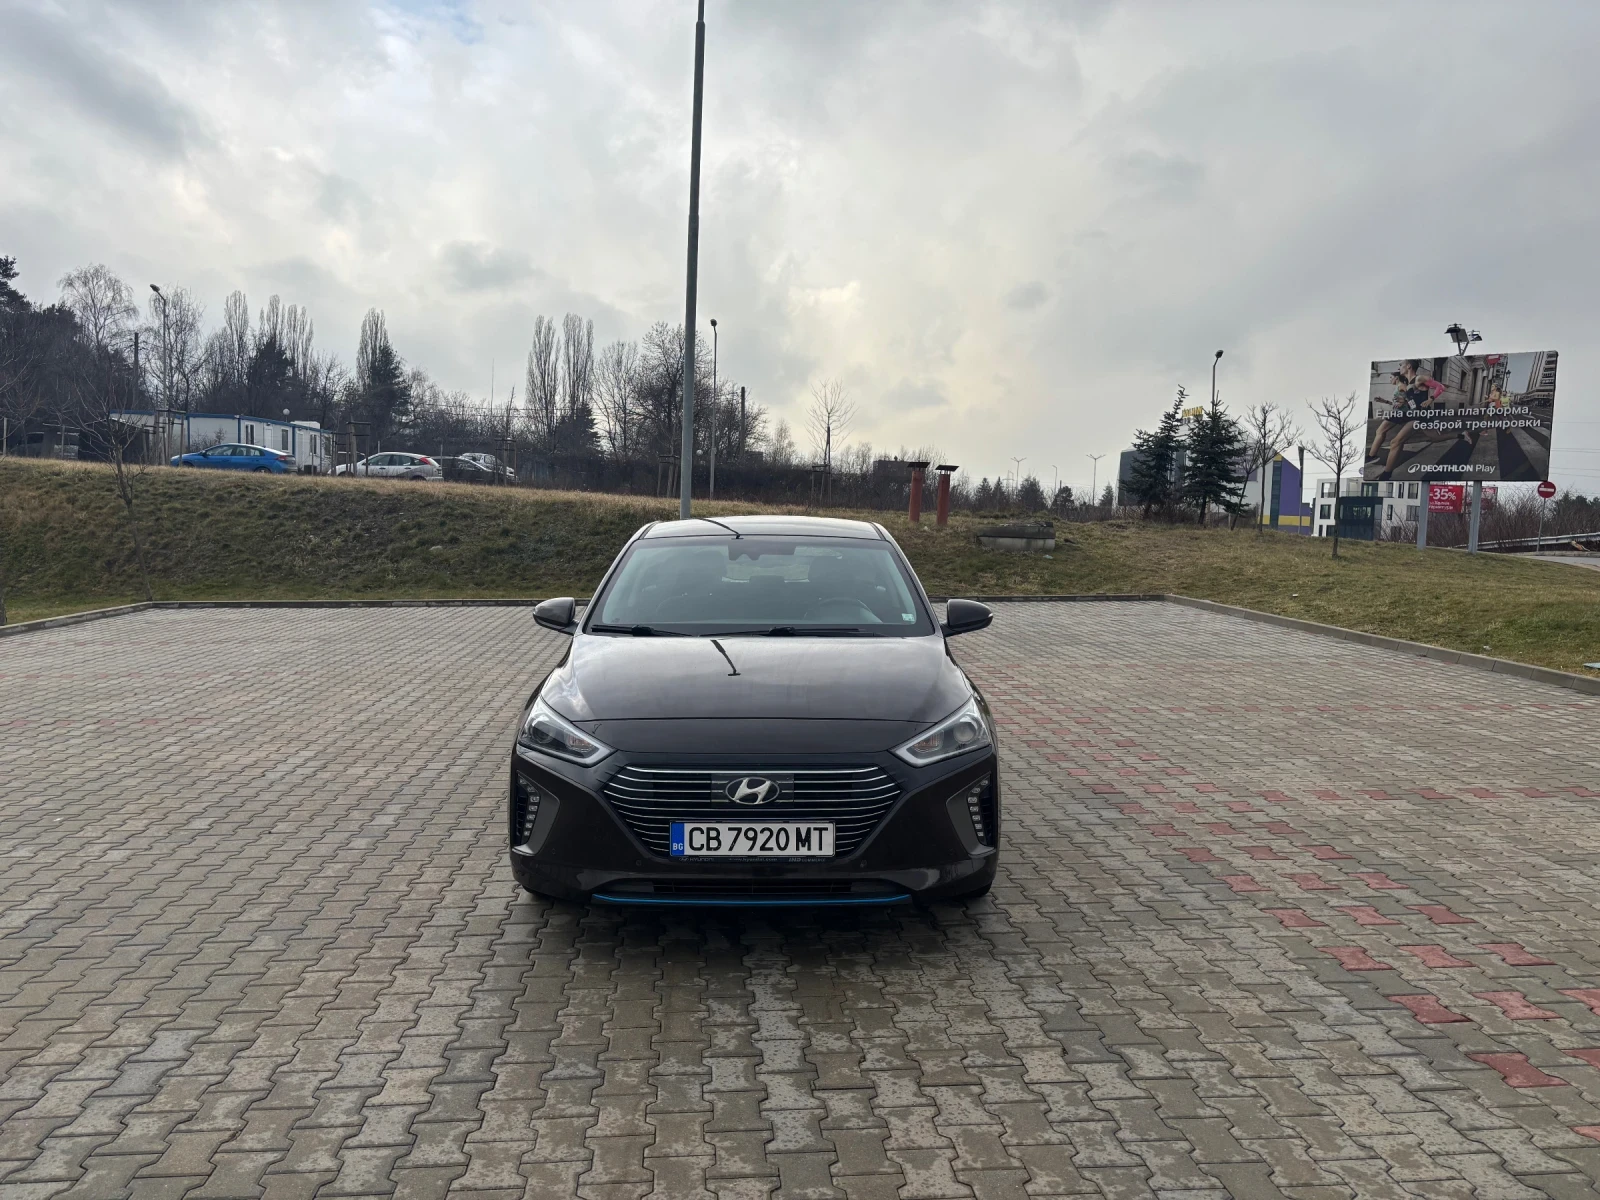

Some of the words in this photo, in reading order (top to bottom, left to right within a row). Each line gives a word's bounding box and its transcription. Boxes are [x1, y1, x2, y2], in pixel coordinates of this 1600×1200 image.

[1375, 408, 1403, 419] Една
[1406, 407, 1455, 419] спортна
[1457, 405, 1532, 417] платформа,
[1412, 419, 1462, 431] безброй
[1465, 418, 1541, 431] тренировки
[1420, 464, 1474, 472] DECATHLON
[1475, 464, 1496, 474] Play
[688, 827, 722, 852] CB
[727, 827, 790, 852] 7920
[795, 827, 829, 852] MT
[672, 843, 684, 851] BG
